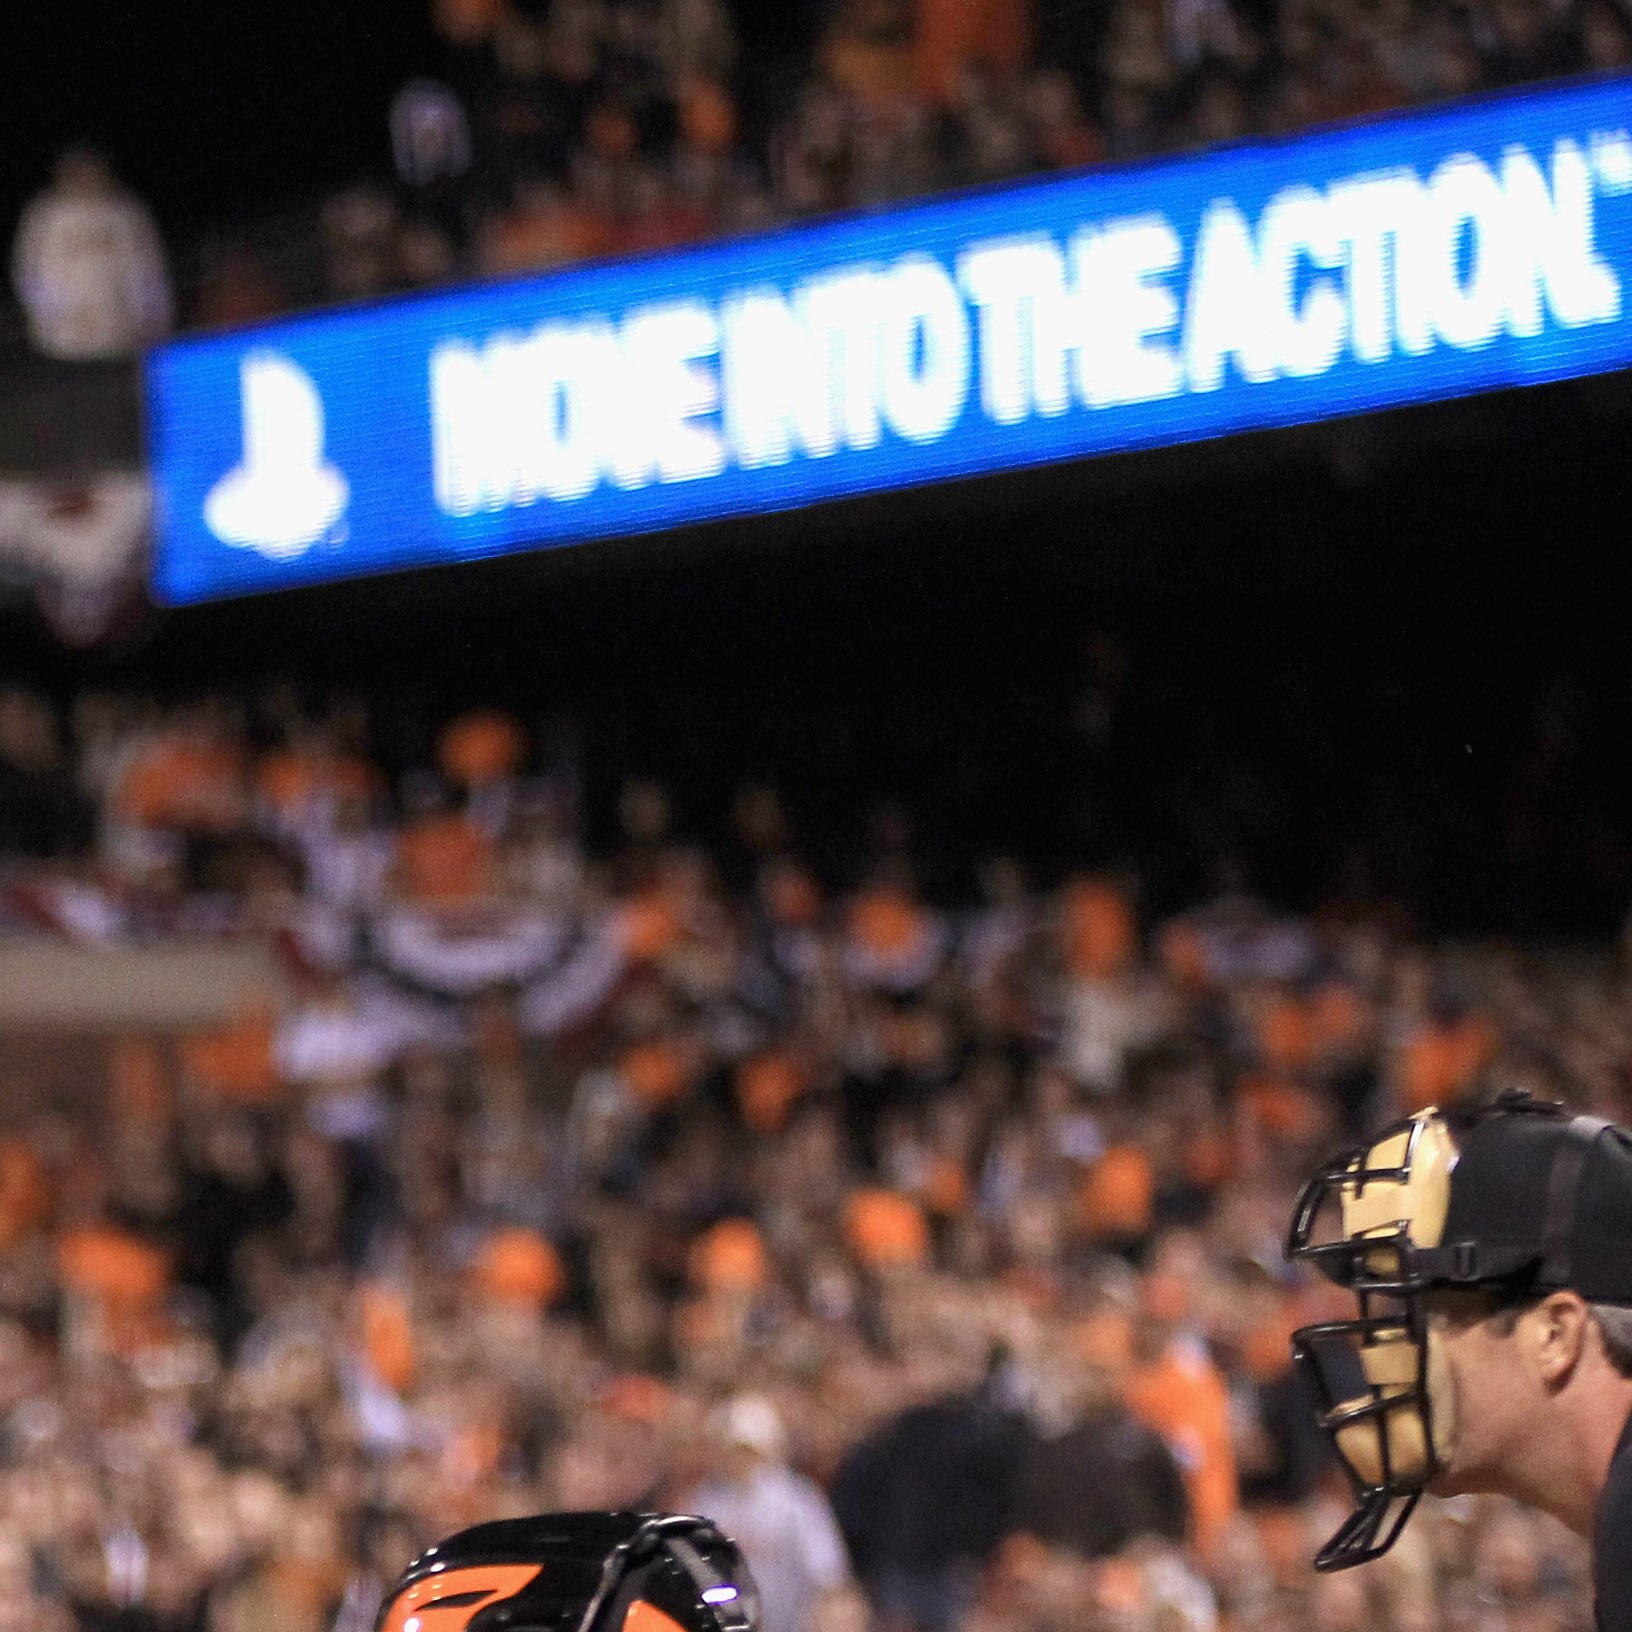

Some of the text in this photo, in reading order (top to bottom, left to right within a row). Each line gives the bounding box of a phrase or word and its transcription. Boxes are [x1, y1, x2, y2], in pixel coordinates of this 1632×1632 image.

[429, 305, 726, 516] MOVE
[724, 257, 974, 469] INTO
[956, 213, 1191, 423] THE
